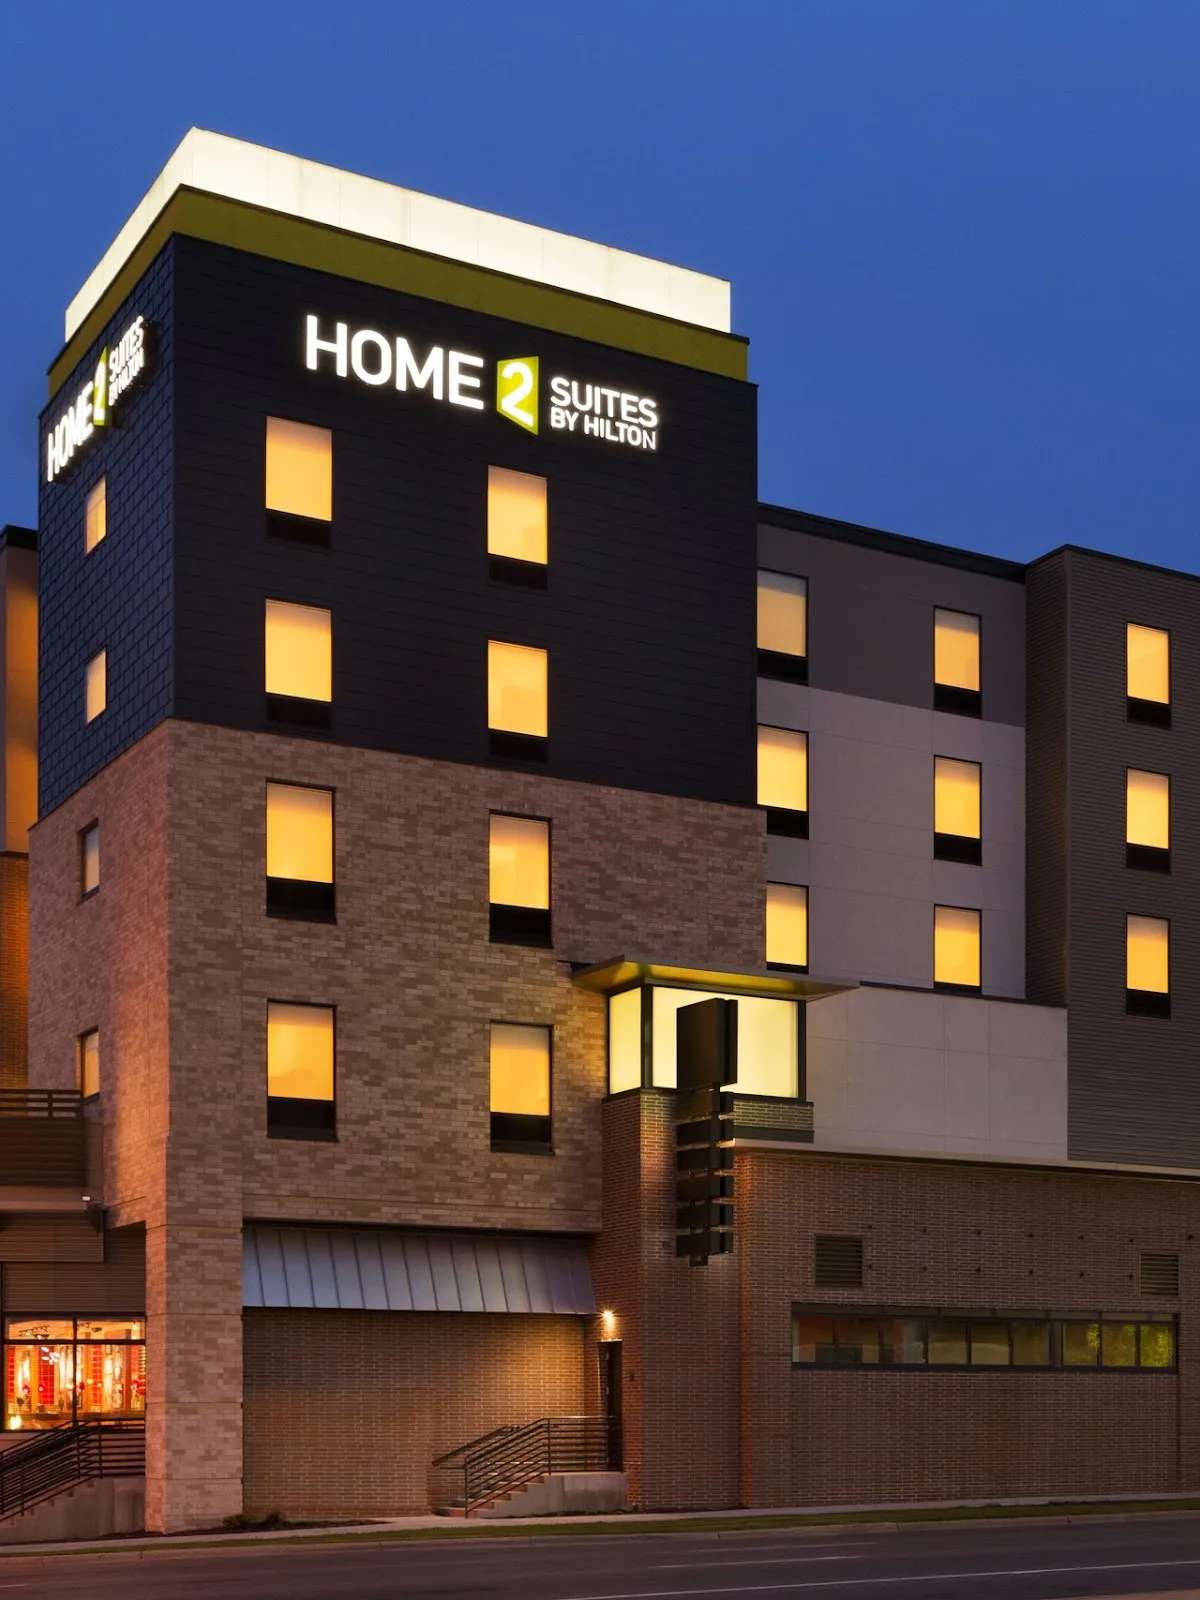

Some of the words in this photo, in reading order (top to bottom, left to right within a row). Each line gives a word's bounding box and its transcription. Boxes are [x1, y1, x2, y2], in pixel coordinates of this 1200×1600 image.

[108, 315, 144, 382] SUITES
[306, 314, 484, 410] HOME
[501, 361, 534, 427] 2
[47, 380, 94, 482] HOME
[93, 361, 107, 421] 2
[550, 376, 659, 428] SUITES
[550, 406, 580, 432] BY
[583, 414, 657, 450] HILTON
